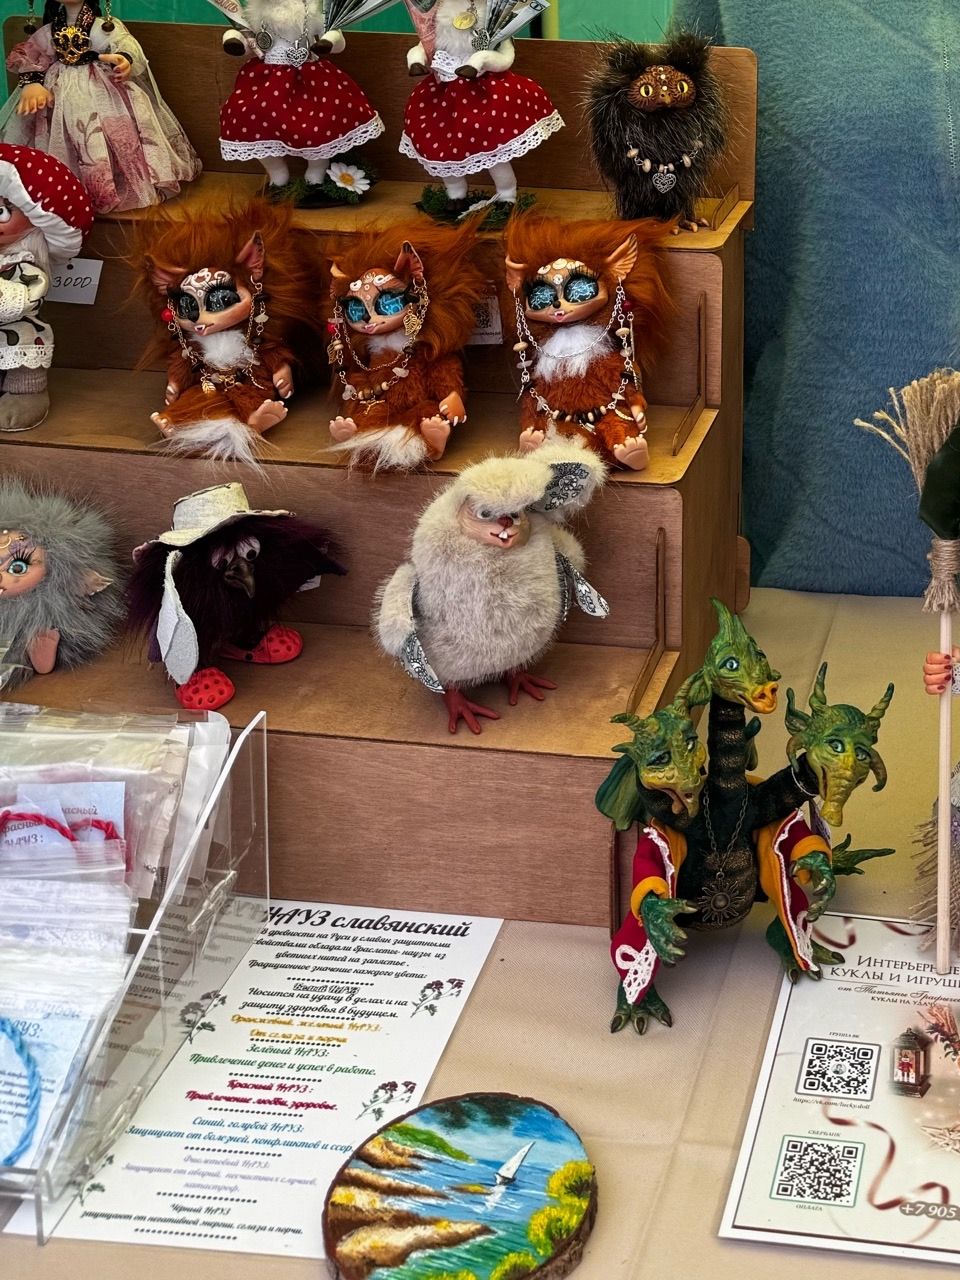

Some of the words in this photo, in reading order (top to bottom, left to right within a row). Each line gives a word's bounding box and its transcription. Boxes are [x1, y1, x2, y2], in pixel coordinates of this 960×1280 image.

[53, 276, 92, 288] 3000
[331, 914, 472, 937] славянский
[268, 929, 316, 938] древности
[330, 933, 351, 941] Руси
[392, 938, 452, 948] защитными
[275, 951, 318, 960] цветных
[317, 955, 347, 963] нитей
[308, 942, 353, 952] обладали
[401, 951, 432, 959] наузы
[248, 959, 311, 971] Традиционное
[311, 965, 353, 973] значение
[353, 968, 394, 977] каждого
[394, 970, 428, 978] цвета:
[830, 967, 884, 981] КУКЛЫ
[889, 973, 901, 982] И
[248, 987, 296, 998] Носится
[309, 994, 344, 1004] удачу
[345, 994, 355, 1002] в
[352, 997, 385, 1005] делах
[854, 984, 909, 998] Татьяны
[871, 996, 898, 1004] КУКЛЫ
[238, 1001, 286, 1012] защиту
[284, 1004, 337, 1014] здоровья
[338, 1005, 348, 1014] в
[347, 1006, 399, 1018] будущем.
[246, 1043, 293, 1055] Зелёный
[294, 1047, 331, 1058] НАУЗ:
[189, 1053, 257, 1067] Привлечение
[257, 1060, 286, 1070] денег
[295, 1063, 326, 1072] успех
[325, 1063, 334, 1071] в
[334, 1064, 377, 1076] работе.
[227, 1078, 273, 1091] Красный
[185, 1090, 252, 1105] Привлечение
[192, 1116, 225, 1128] Синий,
[227, 1120, 268, 1131] голубой
[270, 1122, 304, 1133] НАУЗ:
[125, 1125, 185, 1138] Защищает
[186, 1132, 202, 1140] от
[251, 1137, 321, 1150] конфликтов
[901, 1203, 926, 1215] +7
[927, 1205, 957, 1219] 905
[147, 1216, 199, 1226] негативной
